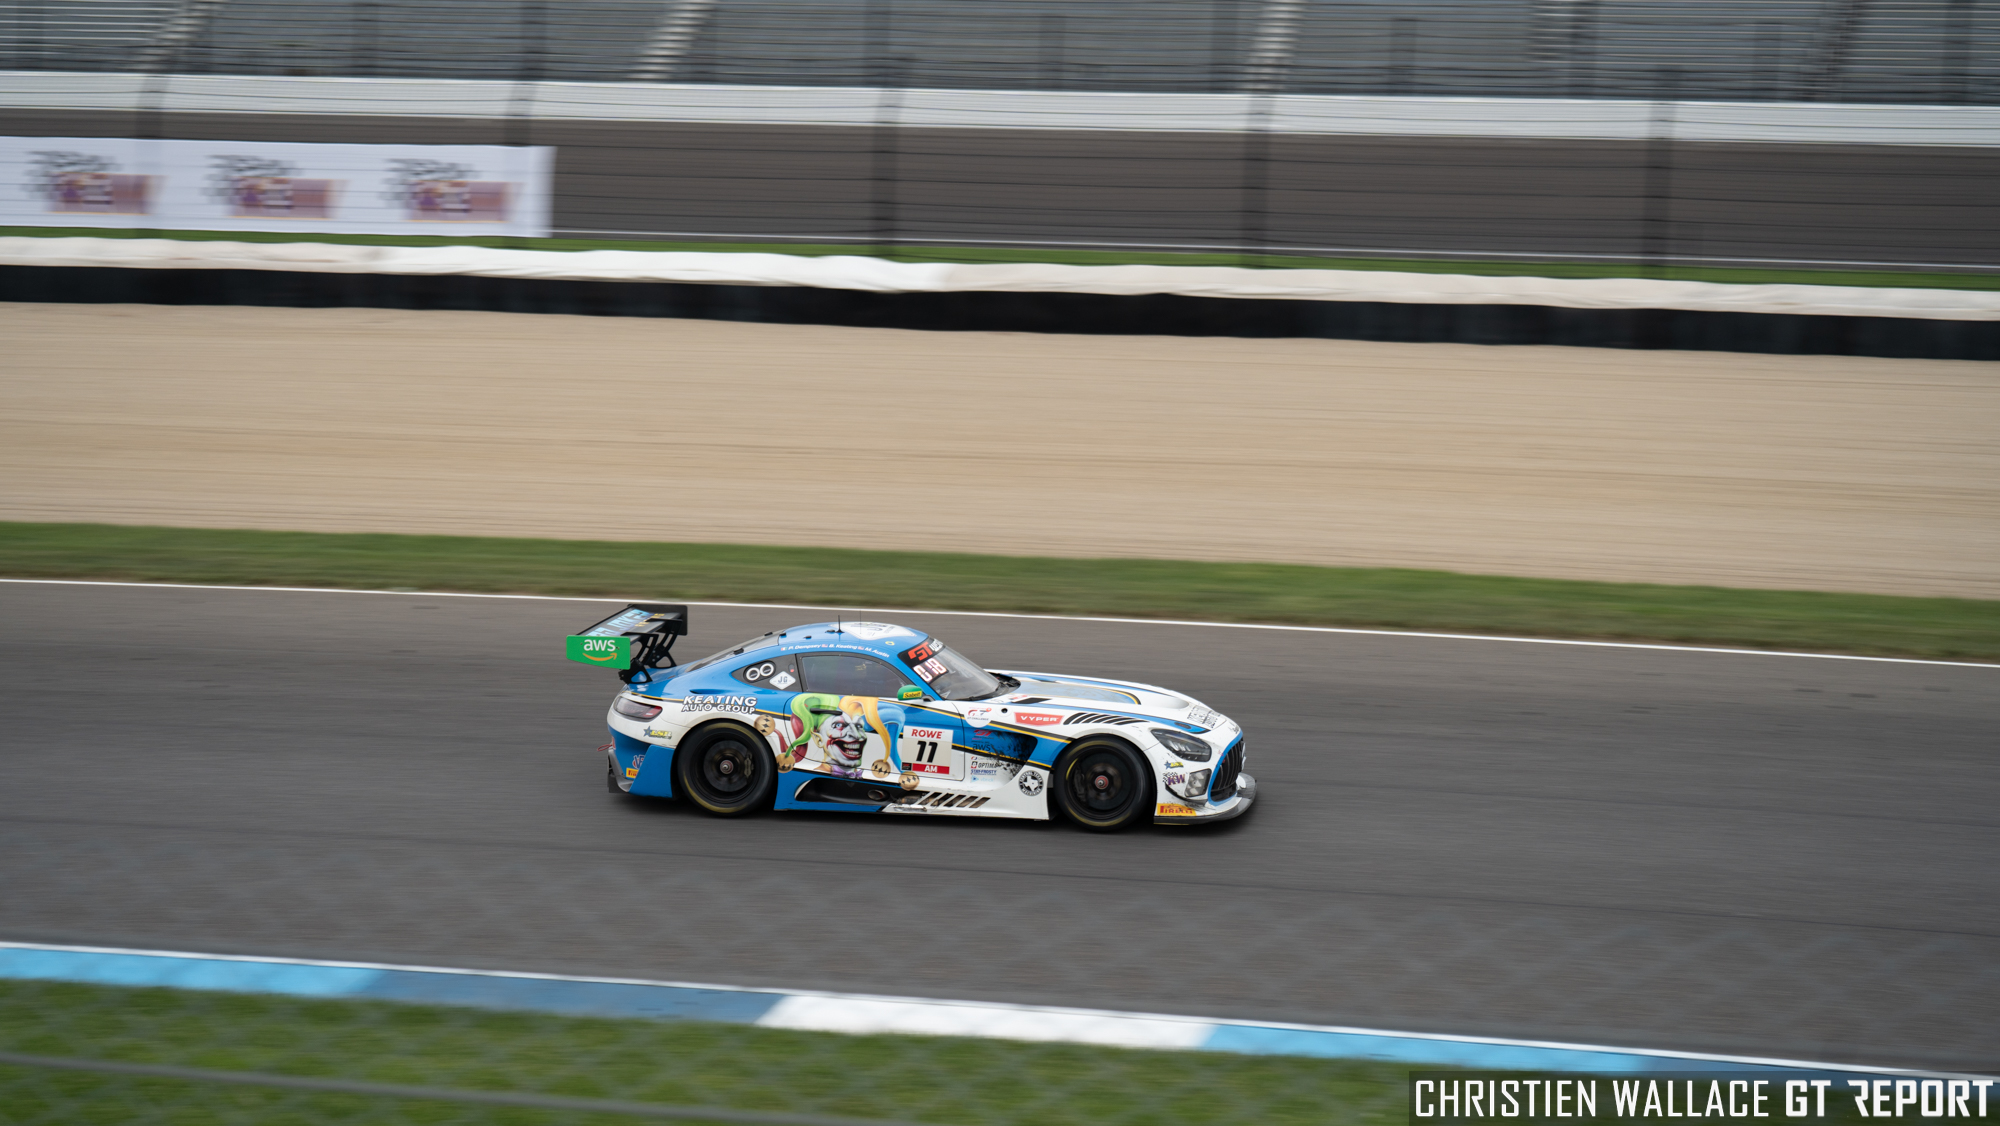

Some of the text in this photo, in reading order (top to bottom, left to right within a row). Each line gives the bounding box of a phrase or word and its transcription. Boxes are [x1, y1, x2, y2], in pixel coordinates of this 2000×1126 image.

[583, 639, 616, 651] aws
[683, 695, 758, 707] KEATING
[681, 704, 756, 714] AUTO GROUP
[911, 729, 943, 739] ROWE
[915, 740, 938, 763] 11
[972, 743, 991, 751] aws
[924, 765, 938, 773] AM
